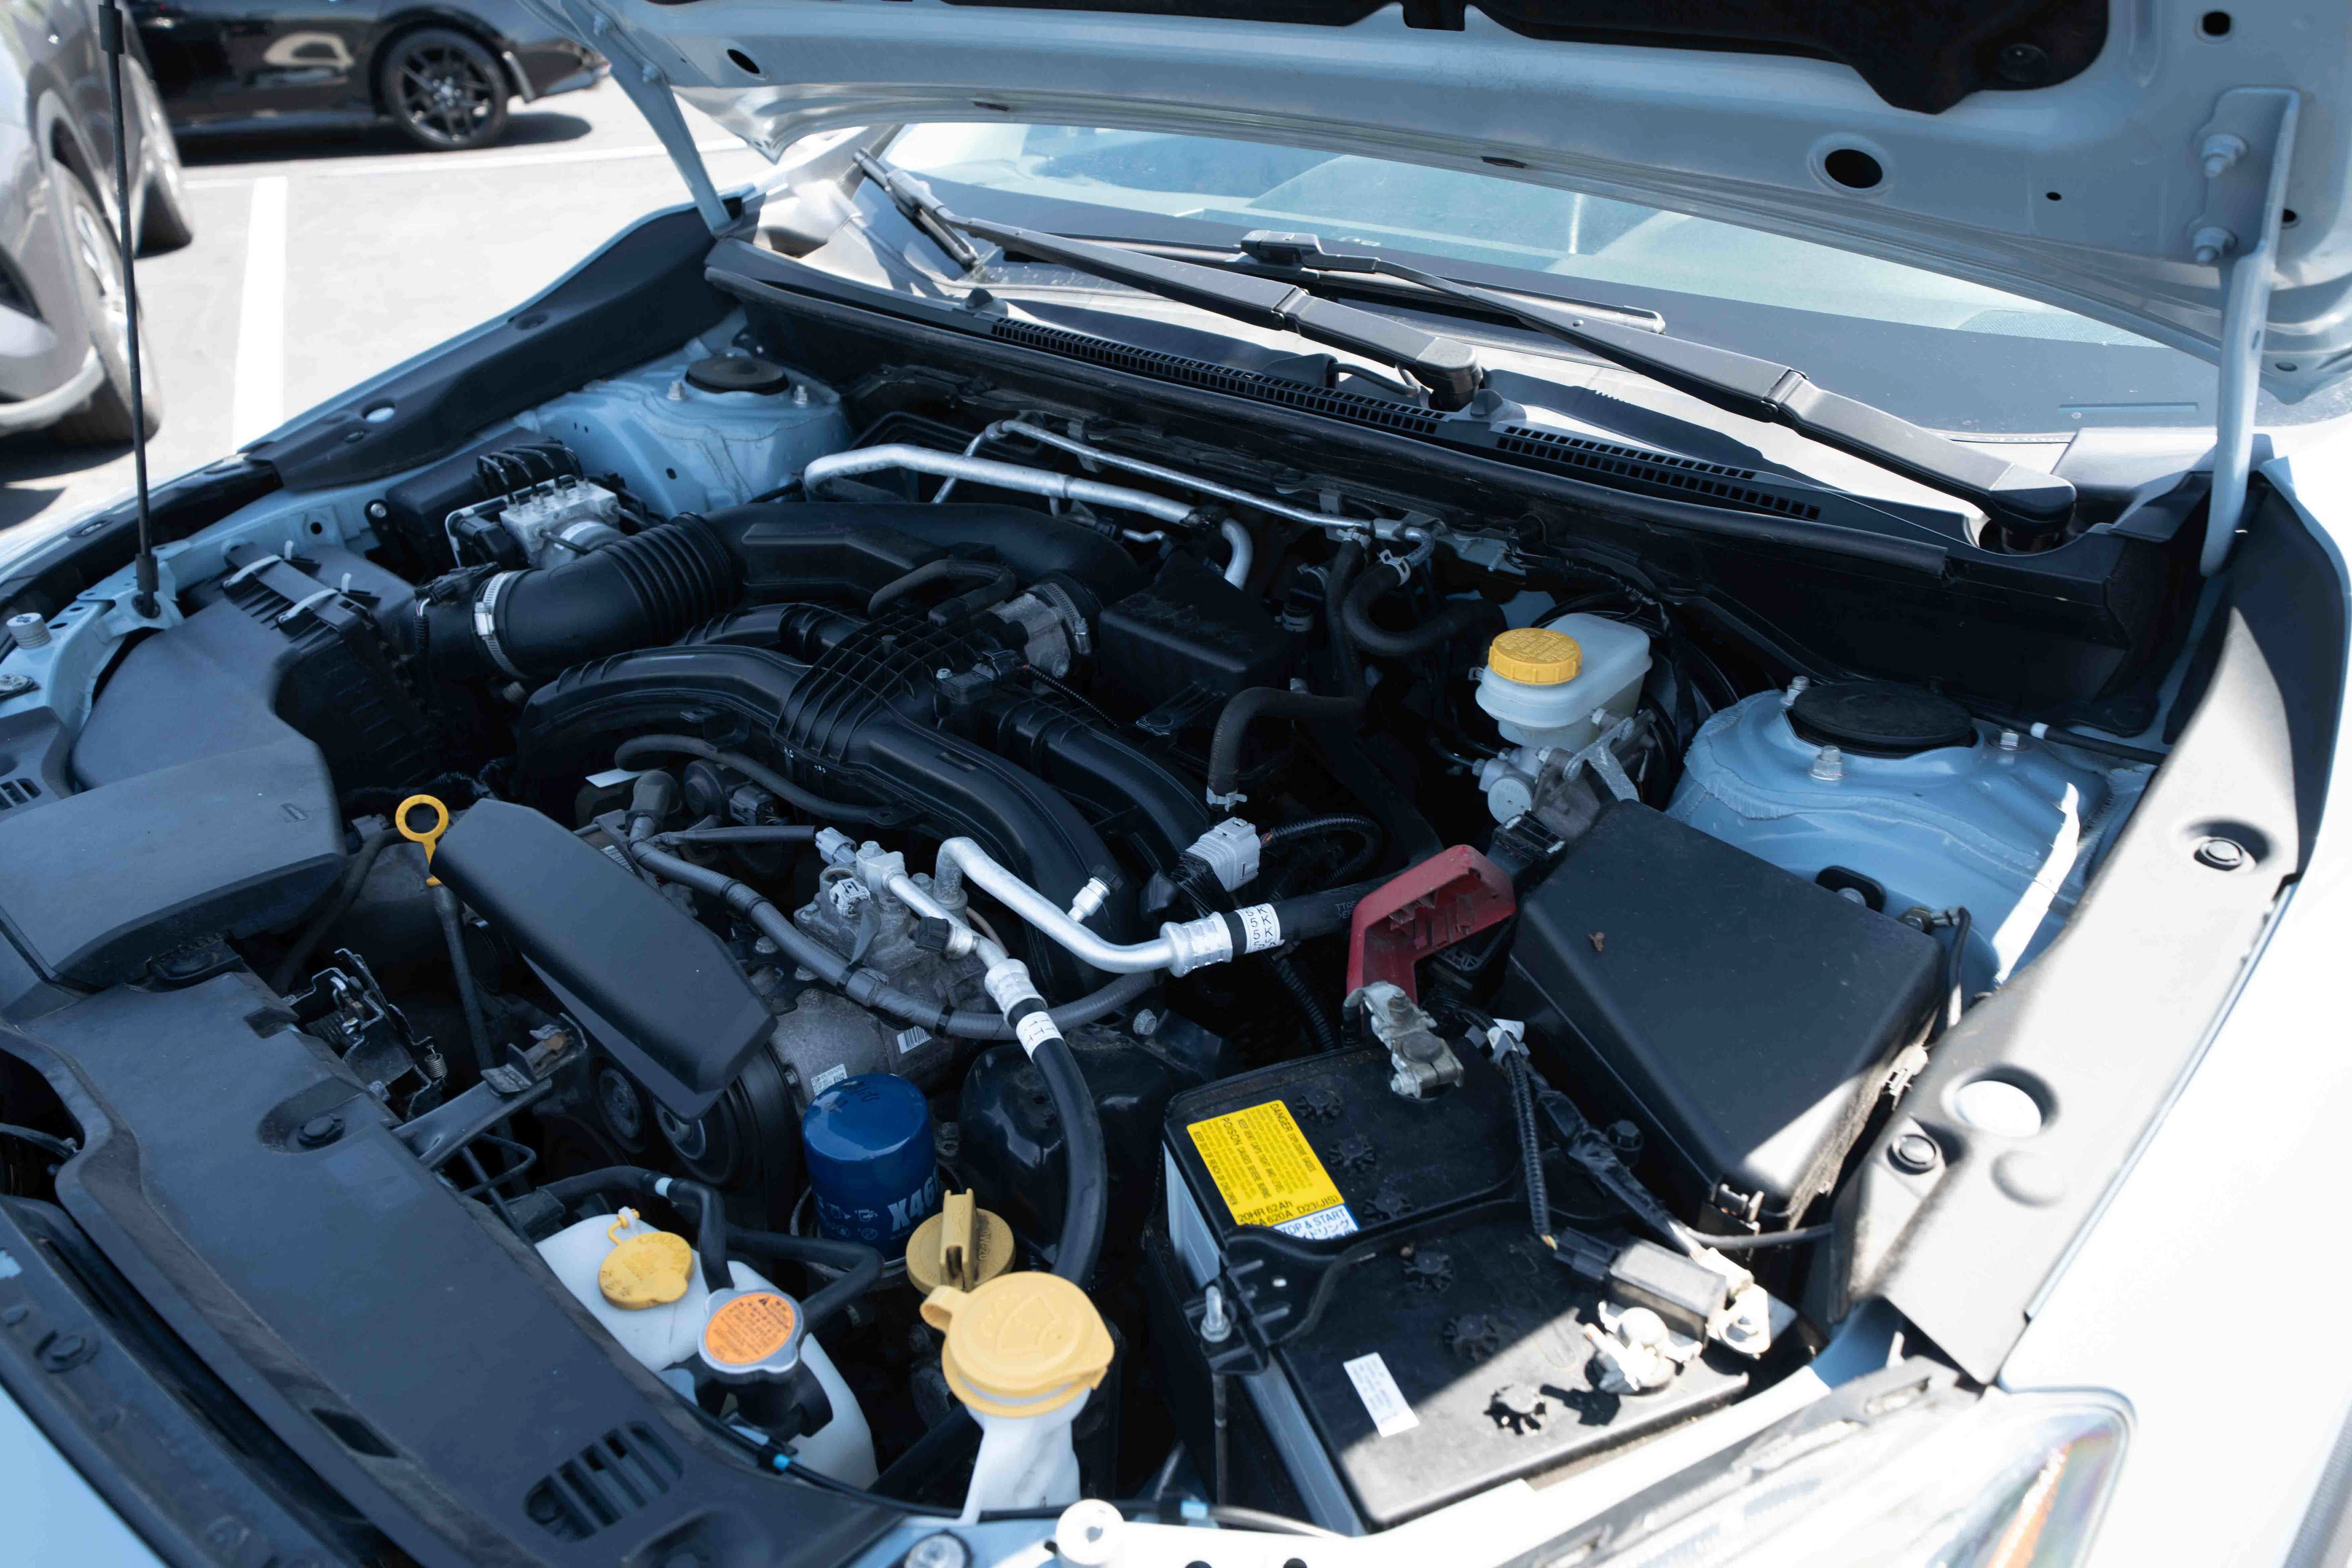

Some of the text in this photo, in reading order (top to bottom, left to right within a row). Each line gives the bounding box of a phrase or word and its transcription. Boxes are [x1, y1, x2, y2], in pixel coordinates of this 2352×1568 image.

[1250, 915, 1272, 927] 5 K
[1254, 927, 1273, 940] 5 K
[1270, 1103, 1293, 1132] DANGER
[1222, 1117, 1241, 1145] POISON
[1237, 1200, 1293, 1223] 20HR 62Ah
[1267, 1210, 1294, 1223] 620A
[1281, 1223, 1301, 1235] TOP
[1313, 1209, 1345, 1225] START
[979, 1229, 991, 1261] 0W-20
